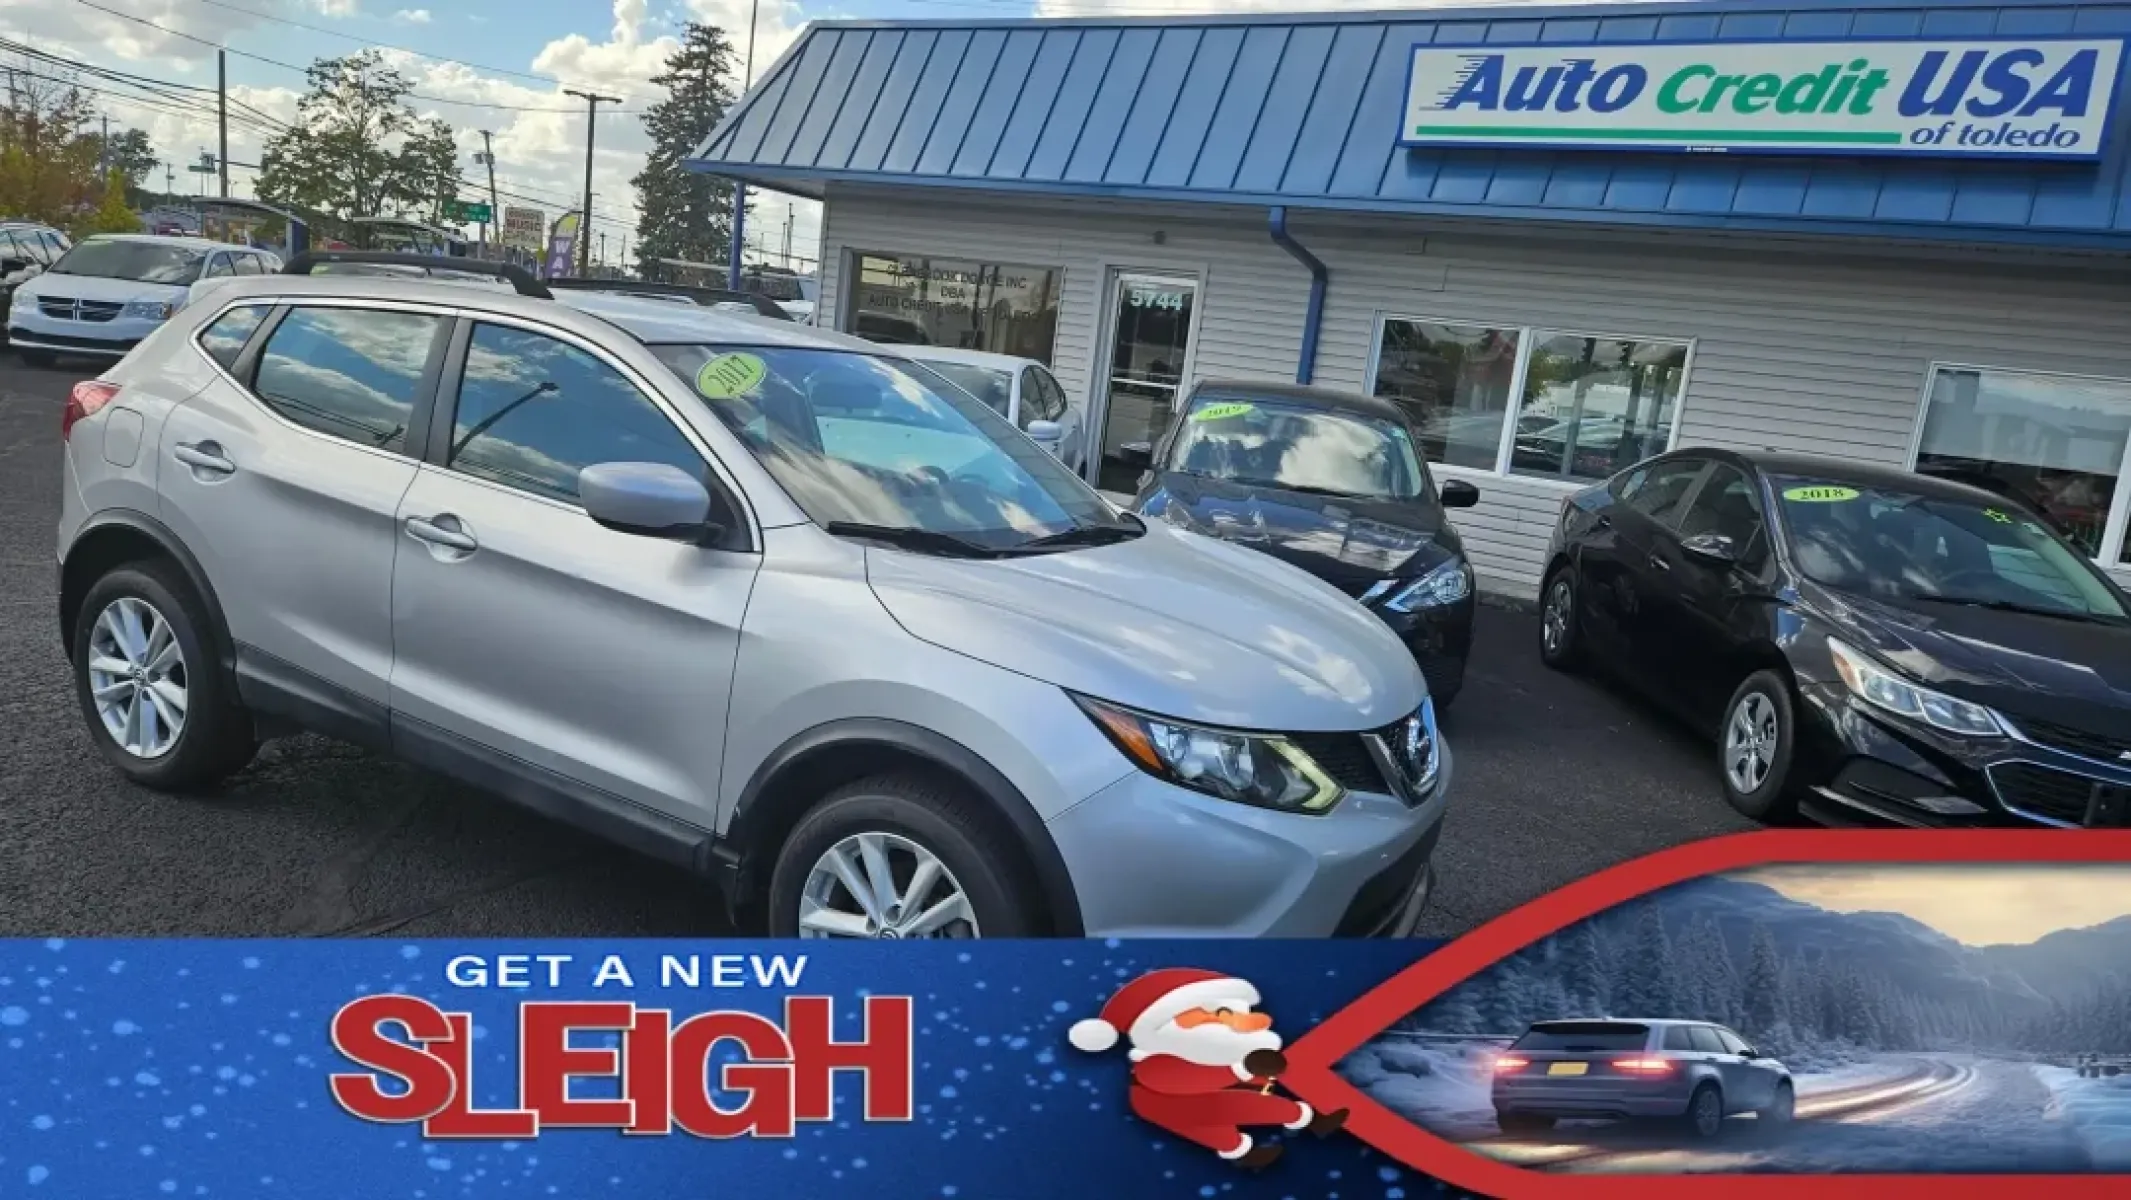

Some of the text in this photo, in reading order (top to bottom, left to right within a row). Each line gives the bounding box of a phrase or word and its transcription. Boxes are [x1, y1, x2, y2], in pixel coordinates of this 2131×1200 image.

[1436, 48, 2099, 118] Auto Credit USA
[1909, 120, 2081, 148] of toledo
[940, 285, 966, 300] DBA
[1129, 288, 1183, 311] 5744
[707, 354, 755, 395] 2017
[1800, 488, 1844, 500] 2018
